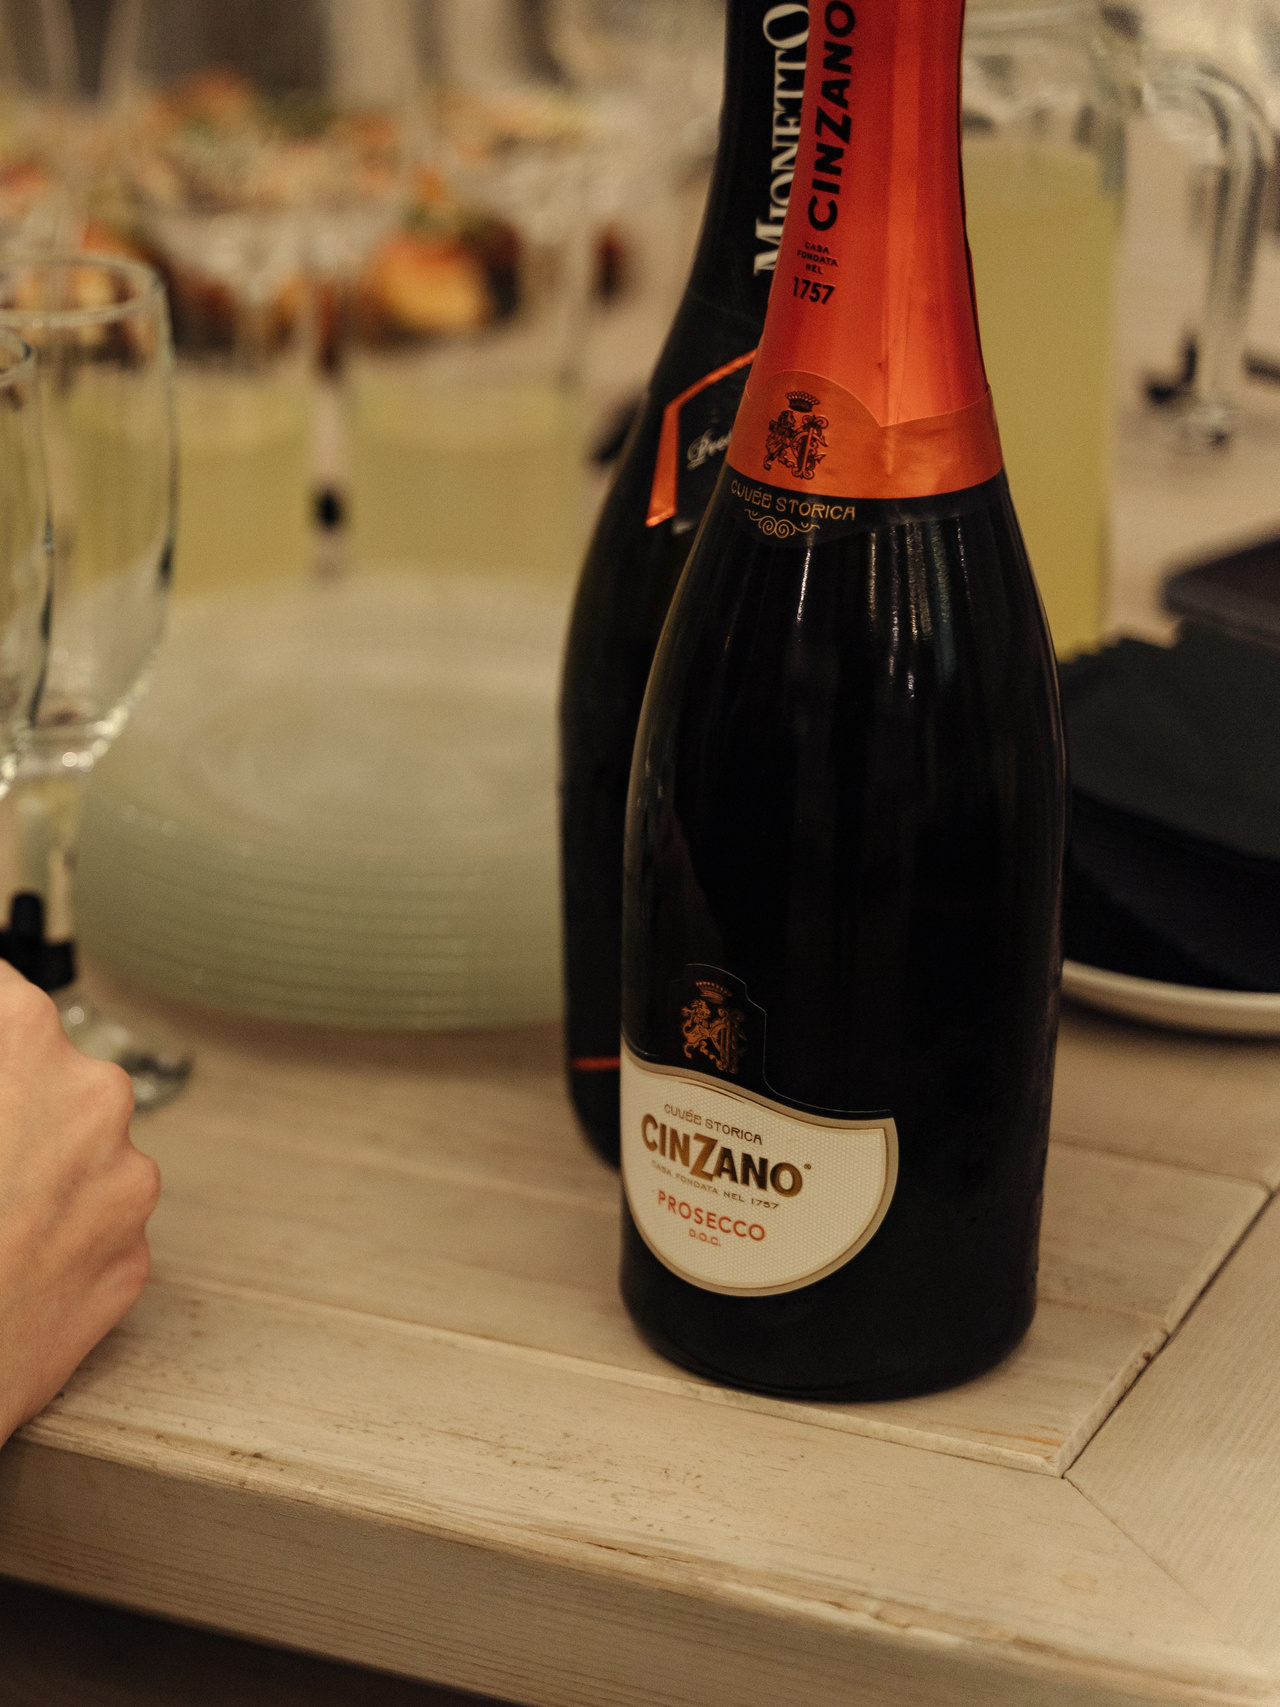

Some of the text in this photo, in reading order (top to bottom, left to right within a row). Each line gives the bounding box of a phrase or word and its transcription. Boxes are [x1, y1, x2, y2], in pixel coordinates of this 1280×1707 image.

[808, 1, 856, 231] CINZANO
[797, 249, 839, 267] FONDATA
[805, 241, 830, 255] CASA
[806, 263, 824, 275] NEL
[793, 276, 836, 304] 1757
[776, 497, 856, 521] STORICA
[705, 1118, 763, 1146] STORICA
[641, 1113, 803, 1198] CINZANO
[651, 1160, 780, 1211] CASA FONDATA NEL 1757
[658, 1189, 766, 1242] PROSECCO
[689, 1228, 721, 1247] D.O.C.
